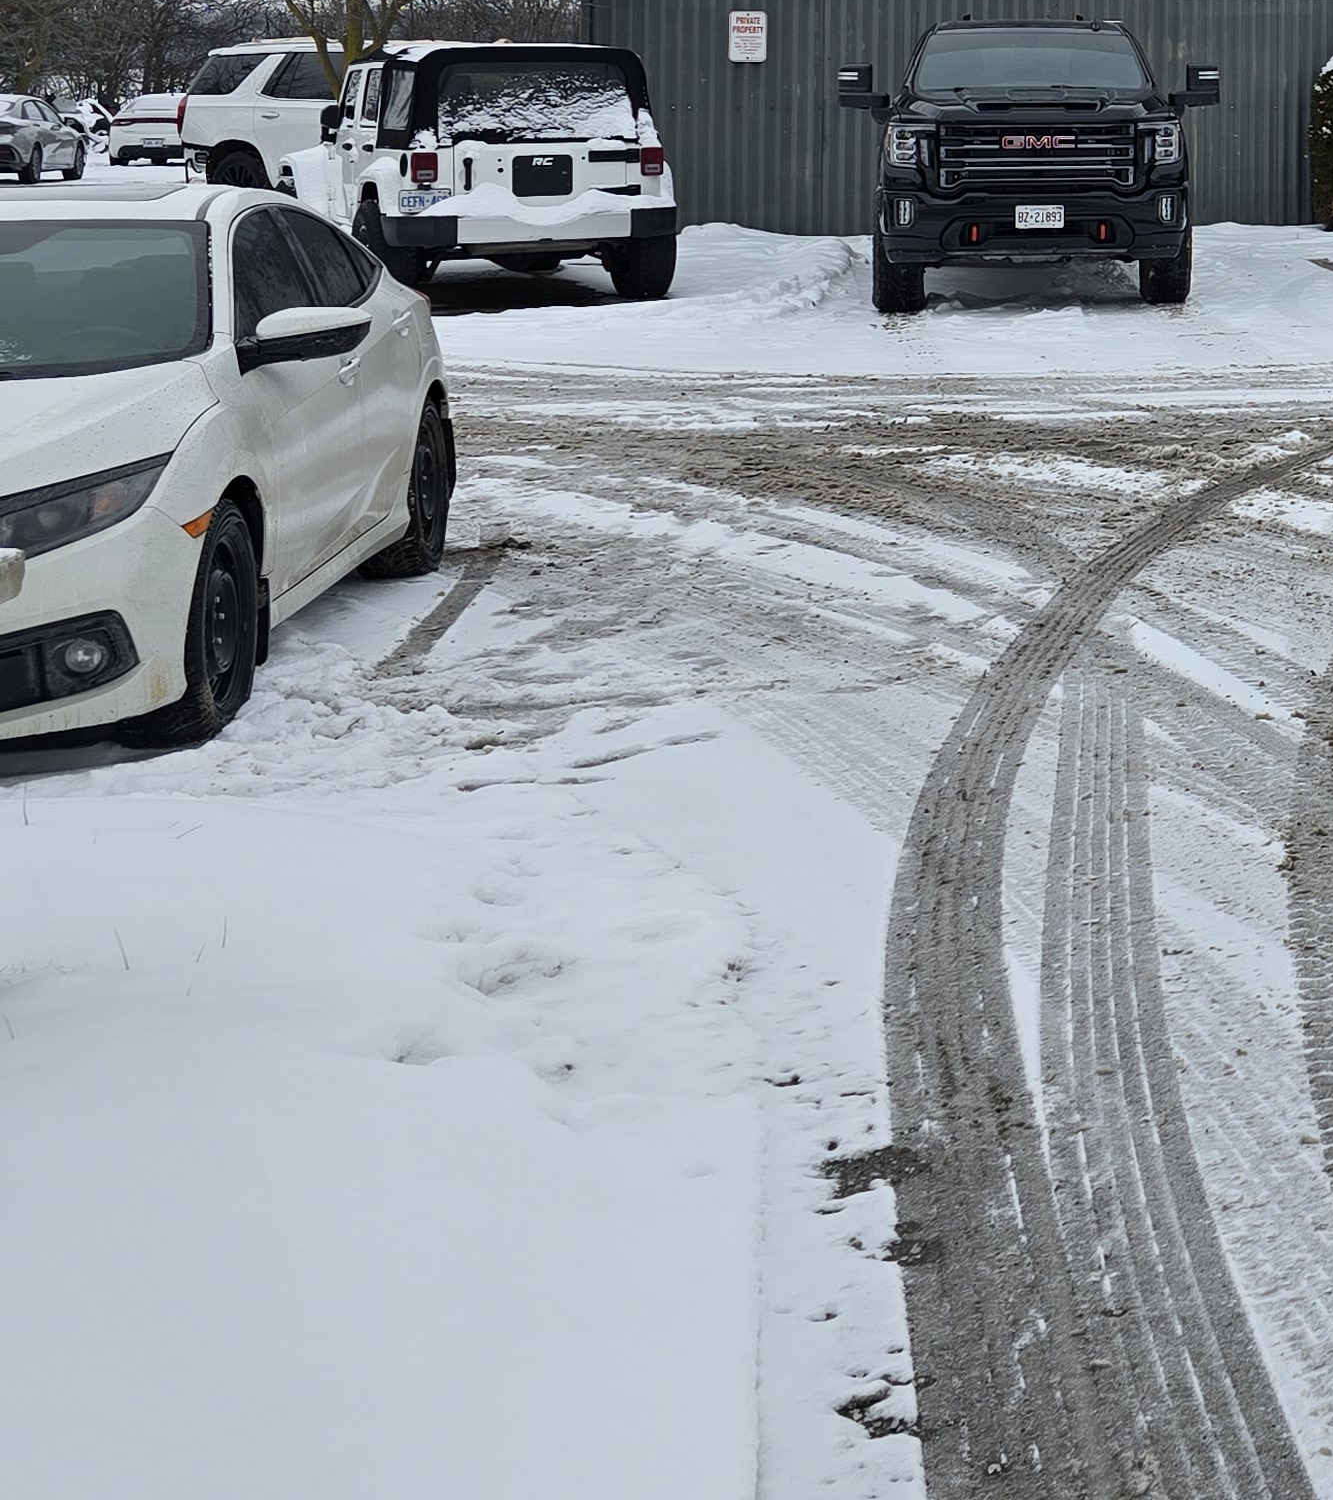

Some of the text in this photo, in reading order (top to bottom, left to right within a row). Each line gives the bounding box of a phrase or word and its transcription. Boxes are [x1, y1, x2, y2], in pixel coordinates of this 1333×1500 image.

[735, 16, 761, 25] PRIVATE
[732, 25, 764, 34] PROPERTY
[1001, 135, 1076, 150] GMC
[532, 157, 554, 166] RC
